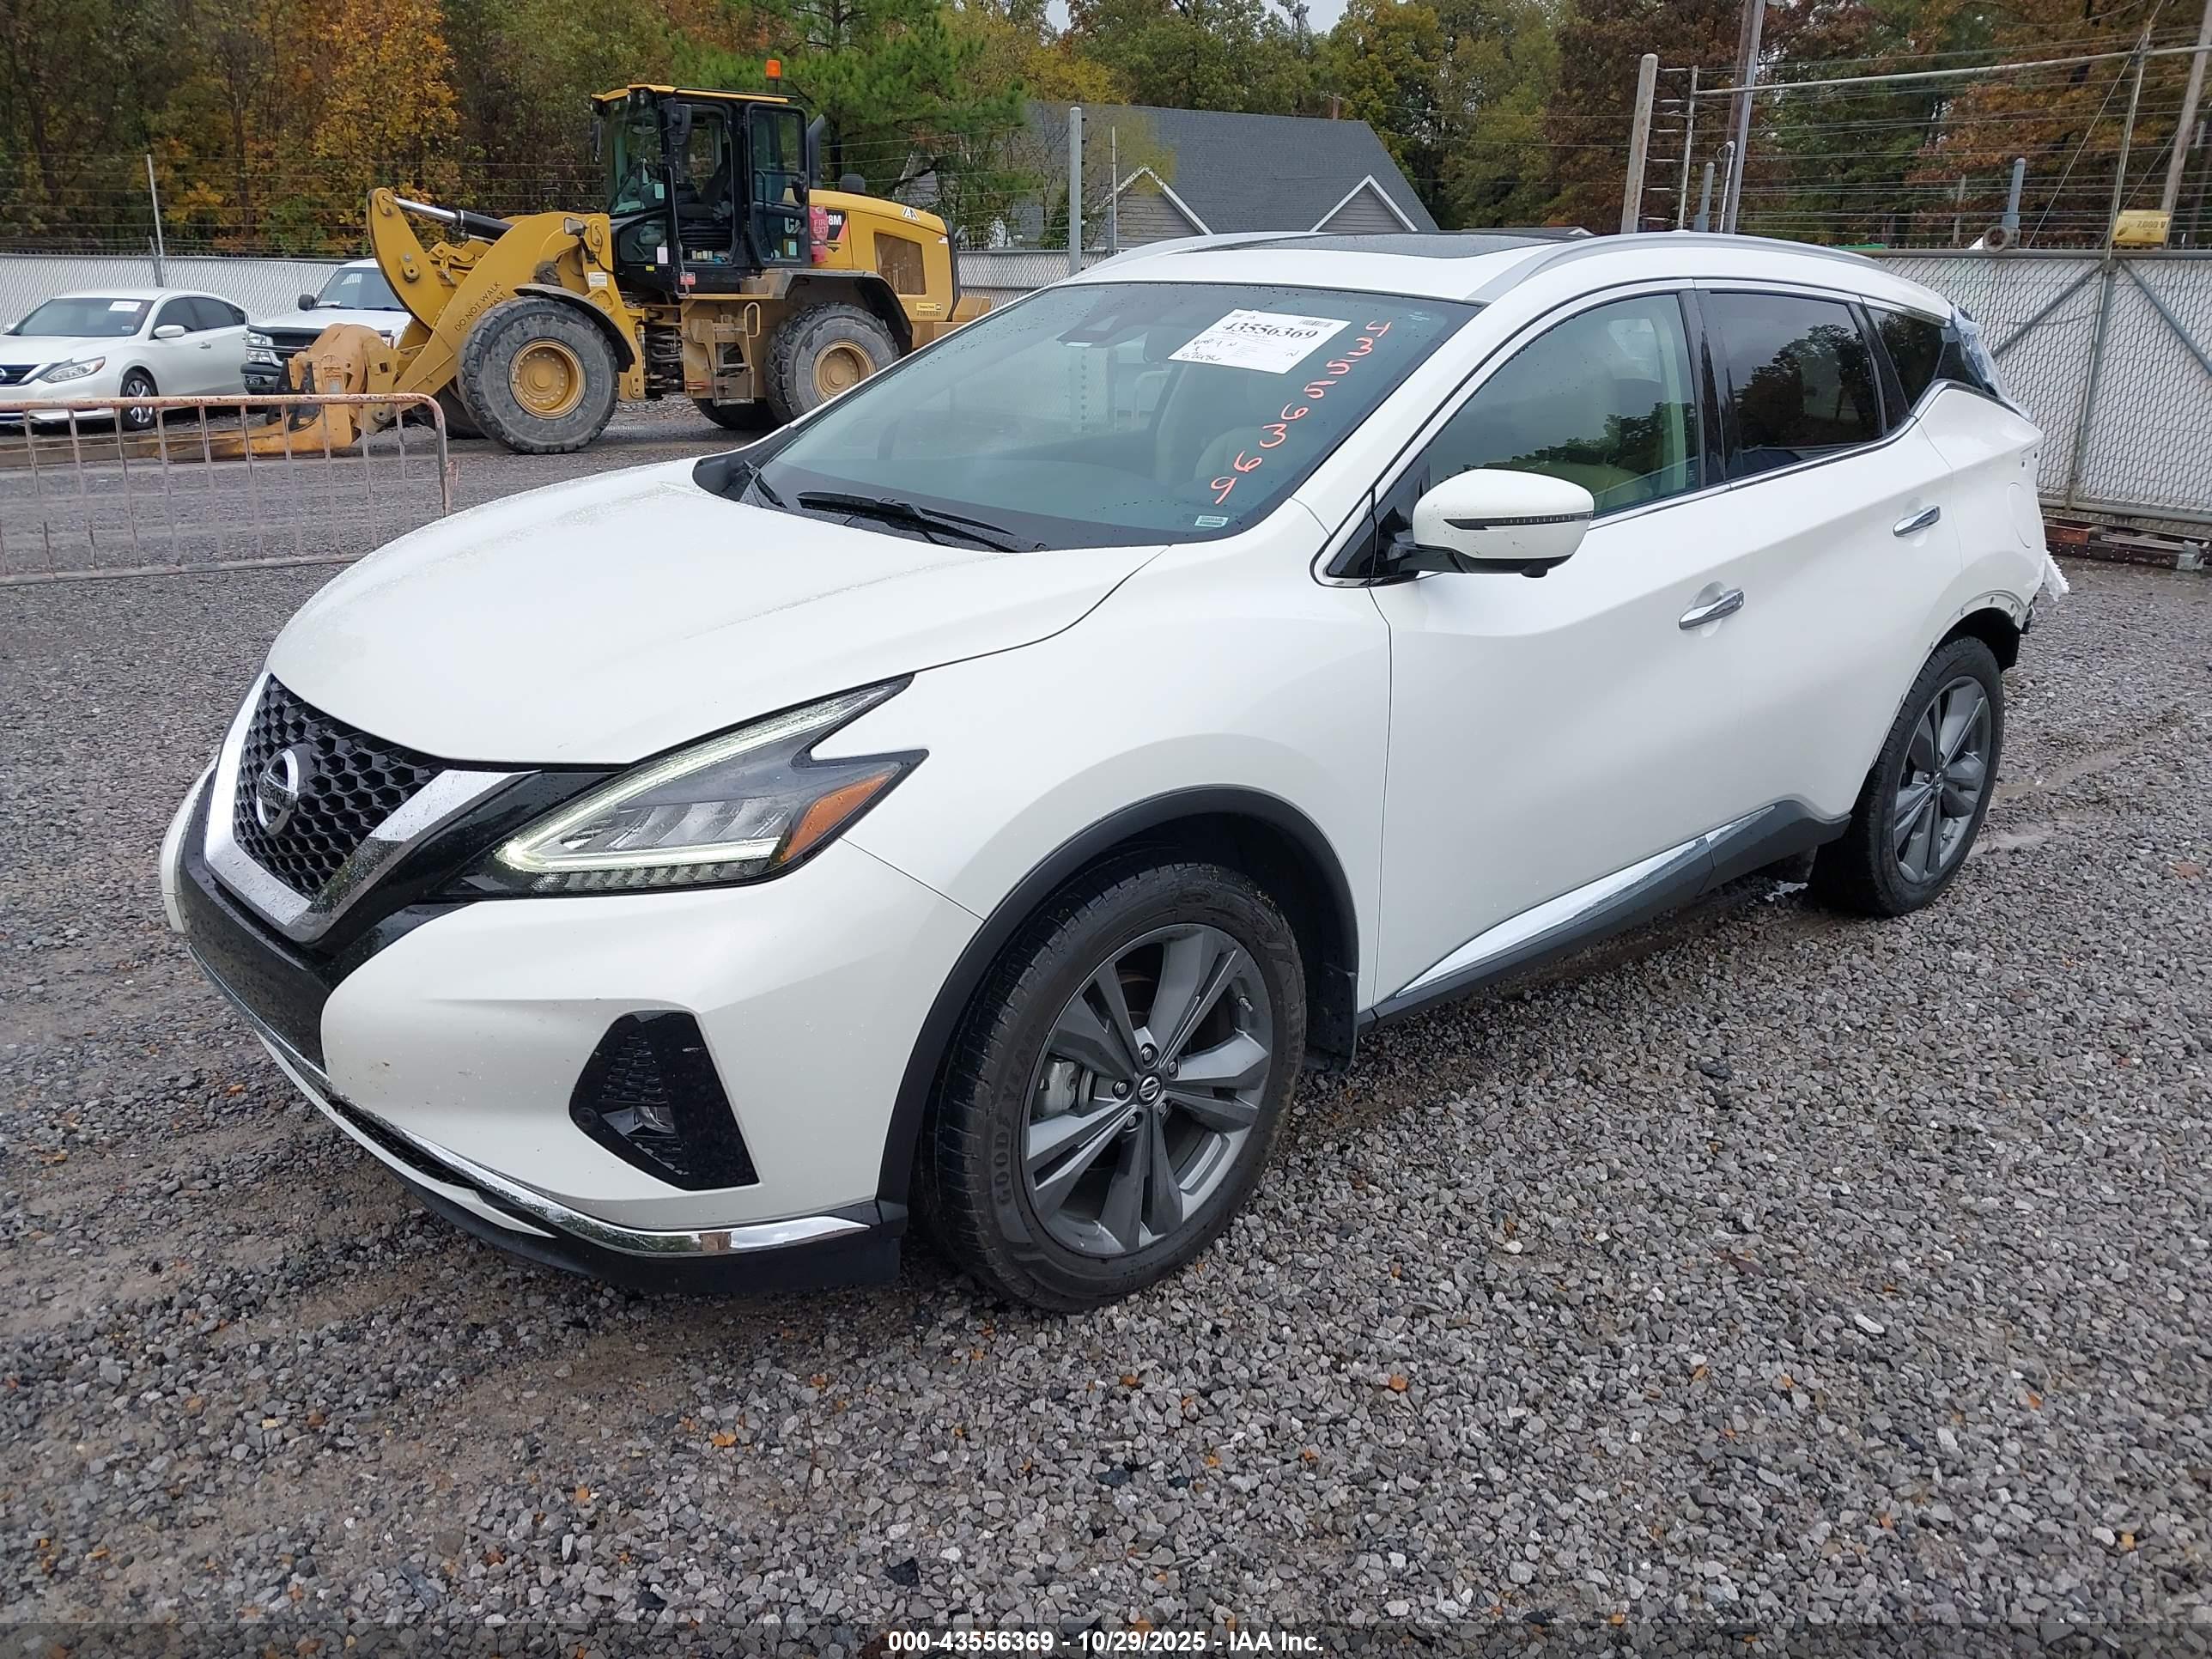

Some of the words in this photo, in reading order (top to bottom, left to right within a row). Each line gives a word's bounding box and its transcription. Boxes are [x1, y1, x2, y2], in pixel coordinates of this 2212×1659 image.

[784, 217, 801, 234] CA
[454, 319, 466, 331] DO
[465, 302, 482, 319] NOT
[480, 282, 501, 302] WALK
[1223, 321, 1319, 340] 43556369
